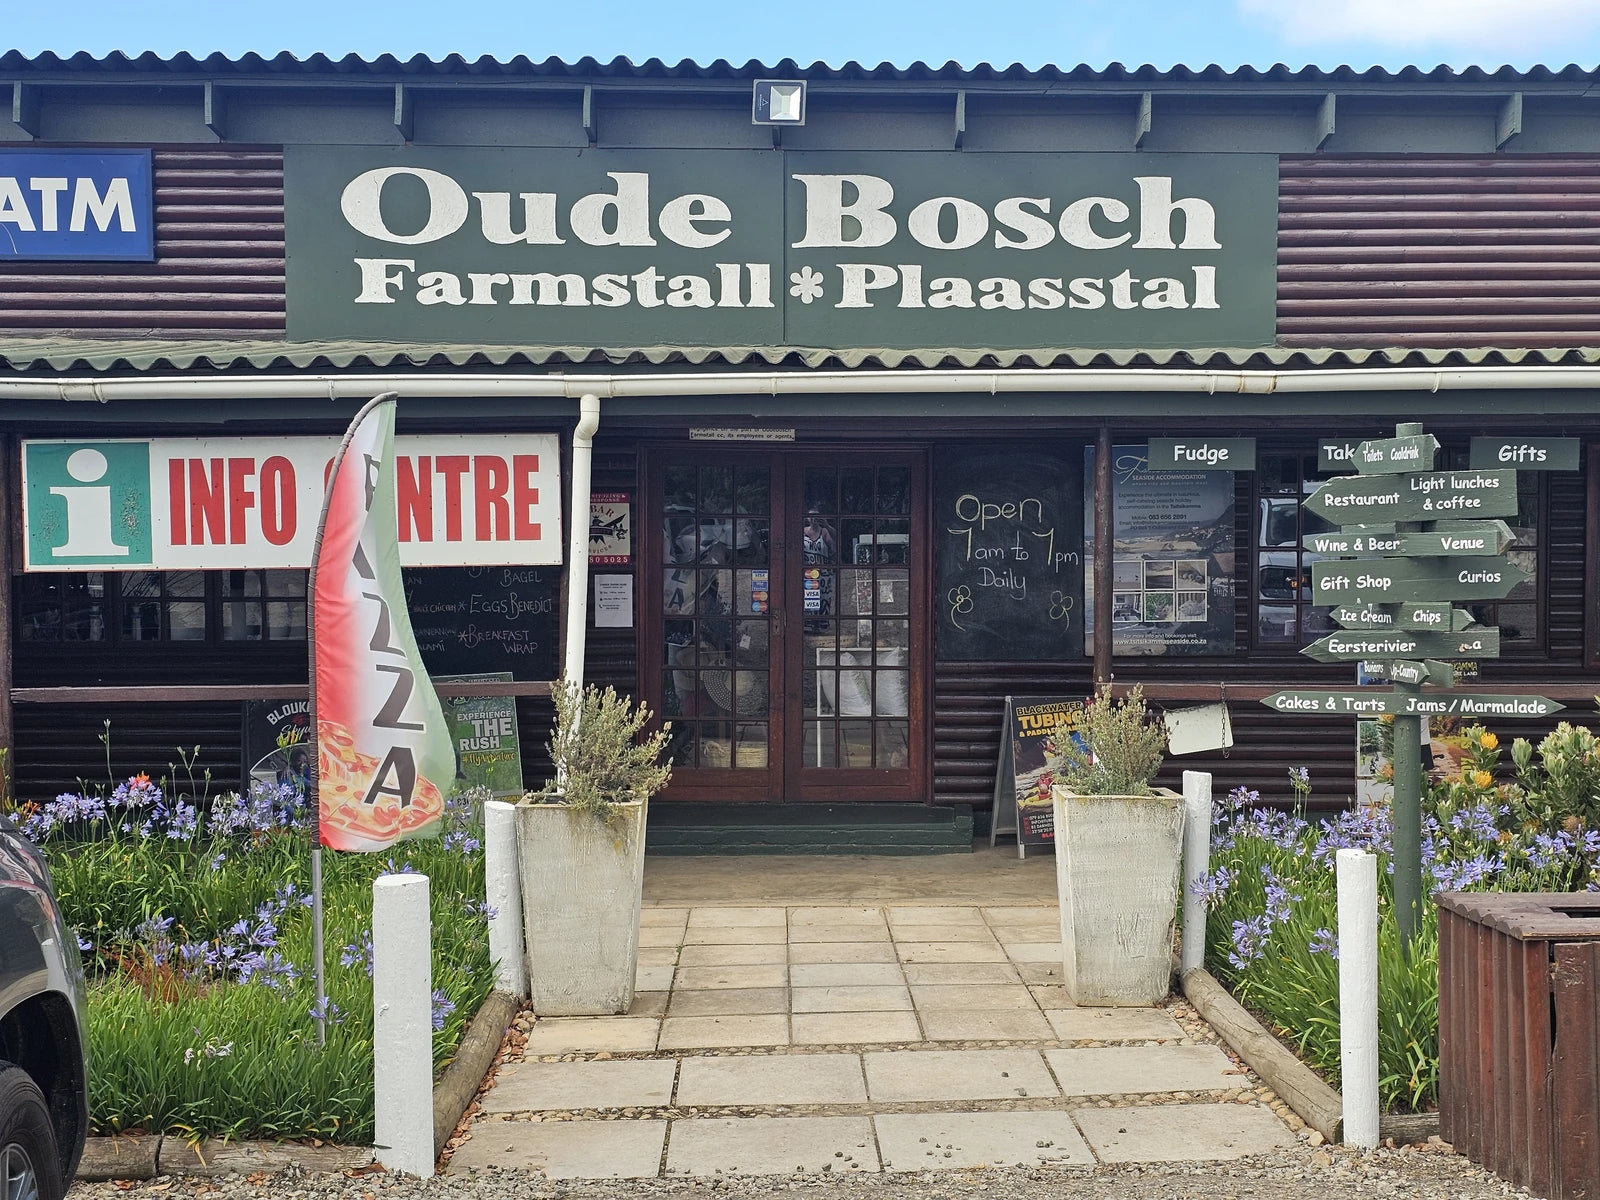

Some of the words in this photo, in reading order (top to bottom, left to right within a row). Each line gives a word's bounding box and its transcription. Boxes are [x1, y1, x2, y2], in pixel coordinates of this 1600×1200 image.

[0, 177, 137, 232] ATM
[340, 166, 732, 248] Oude
[791, 173, 1223, 250] Bosch
[353, 258, 776, 308] Farmstall
[834, 263, 1221, 310] Plaasstal
[1174, 444, 1229, 465] Fudge
[1323, 443, 1355, 460] Tak
[1362, 447, 1384, 462] Toilets
[1391, 445, 1419, 460] Cooldrink
[1498, 445, 1547, 462] Gifts
[1410, 478, 1446, 493] Light
[1450, 475, 1500, 489] lunches
[169, 455, 297, 547] INFO
[1324, 493, 1400, 507] Restaurant
[1422, 500, 1433, 511] &
[1436, 497, 1481, 510] coffee
[955, 494, 1042, 531] Open
[1010, 530, 1029, 560] to
[1315, 539, 1348, 552] Wine
[1353, 540, 1364, 551] &
[1368, 538, 1400, 550] Beer
[1441, 536, 1484, 550] Venue
[500, 569, 542, 588] BAGEL
[977, 567, 1027, 600] Daily
[1320, 577, 1350, 590] Gift
[1356, 574, 1391, 591] Shop
[1458, 571, 1501, 583] Curios
[470, 594, 507, 614] EGGS
[1340, 609, 1357, 622] Ice
[1360, 609, 1392, 624] Cream
[1412, 609, 1441, 623] Chips
[465, 623, 529, 648] BREAKFAST
[503, 642, 538, 654] WRAP
[1328, 639, 1416, 653] Eersterivier
[1016, 701, 1083, 716] BLACKWATER
[1276, 696, 1319, 709] Cakes
[1325, 697, 1336, 709] &
[1342, 698, 1386, 711] Tarts
[457, 711, 511, 721] EXPERIENCE
[471, 718, 513, 738] THE
[460, 736, 500, 751] RUSH
